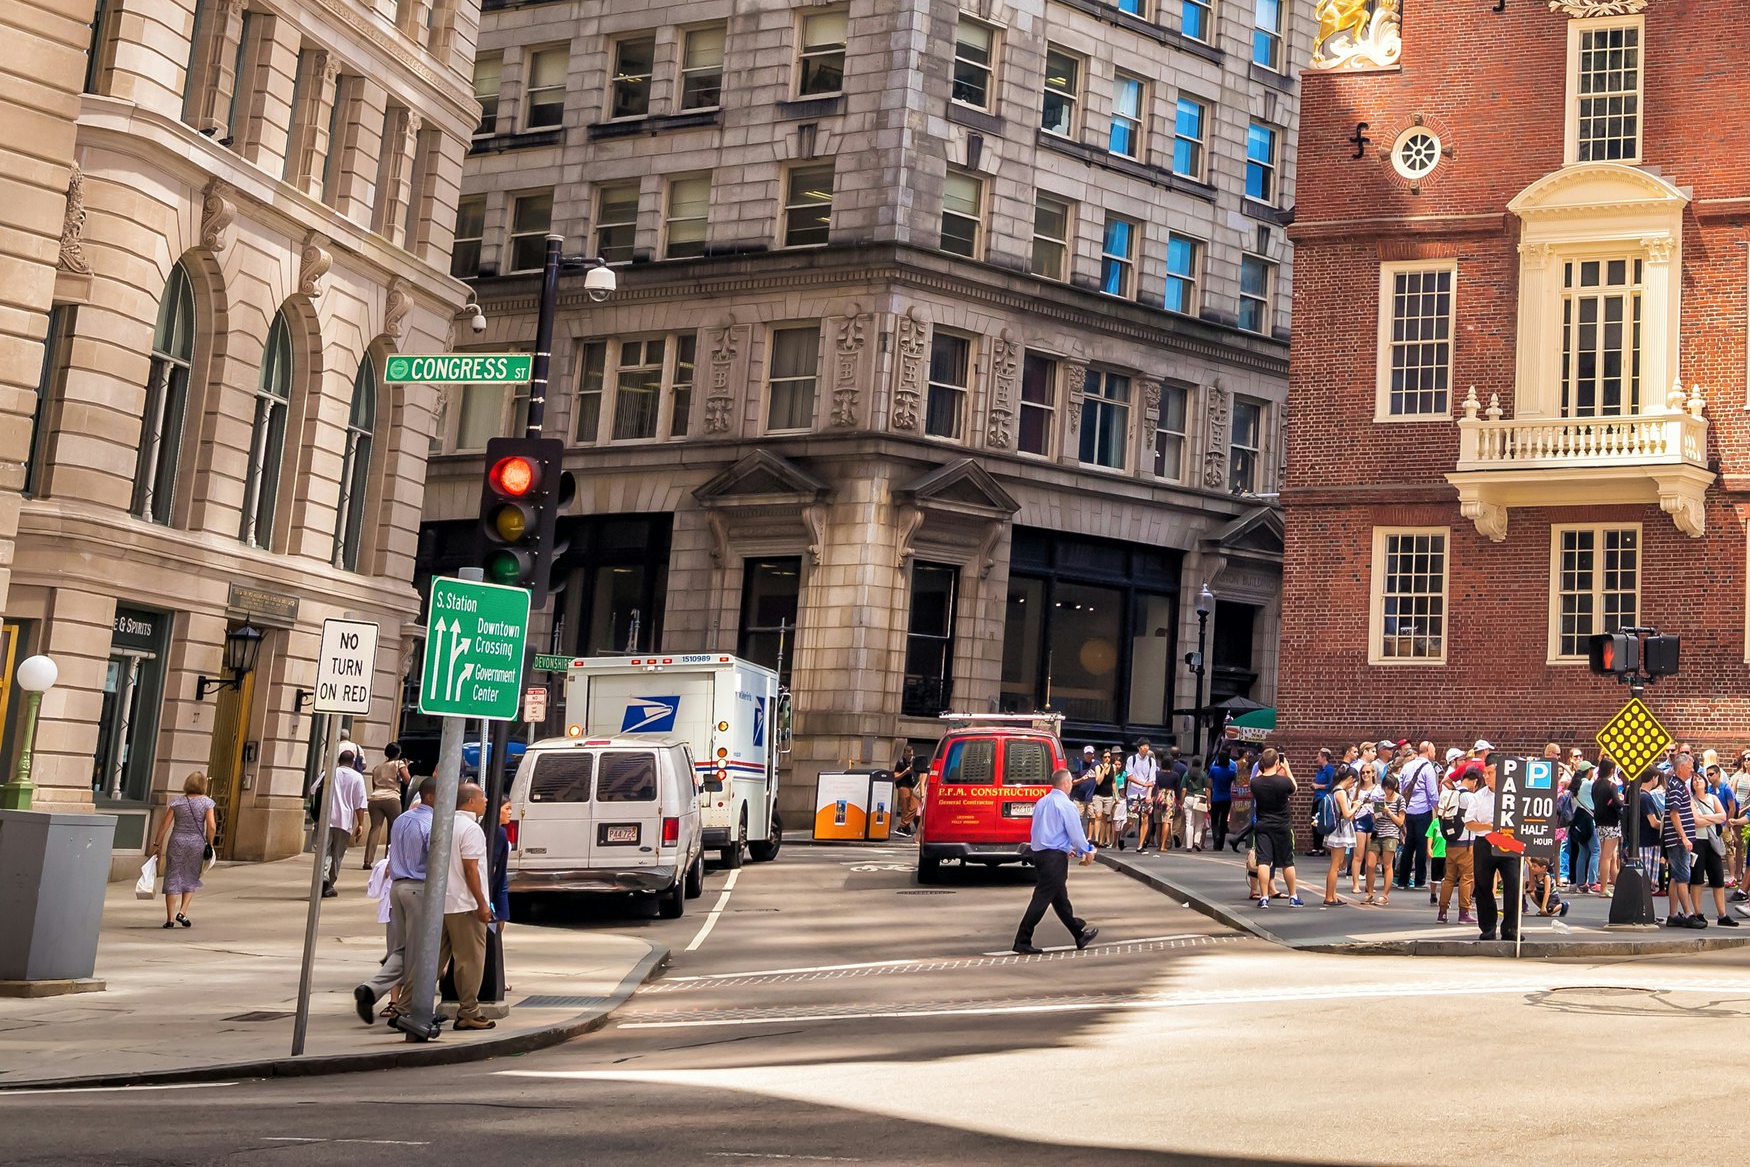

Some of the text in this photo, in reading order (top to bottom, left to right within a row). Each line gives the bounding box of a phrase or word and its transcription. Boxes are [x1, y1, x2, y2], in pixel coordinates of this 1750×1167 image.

[411, 357, 527, 380] CONGRESS ST
[436, 591, 478, 613] S. Station
[119, 616, 126, 632] &
[477, 617, 520, 638] Downtown
[340, 632, 359, 650] NO
[475, 636, 513, 661] Crossing
[332, 657, 363, 677] TURN
[682, 655, 711, 663] 1510989
[475, 663, 517, 684] Government
[320, 682, 367, 703] ON RED
[473, 684, 500, 703] Center
[970, 787, 1047, 797] CONSTRUCTION
[1500, 759, 1518, 827] PARK
[1522, 797, 1553, 817] 7.00
[1520, 824, 1549, 835] HALF
[1533, 837, 1554, 846] HOUR
